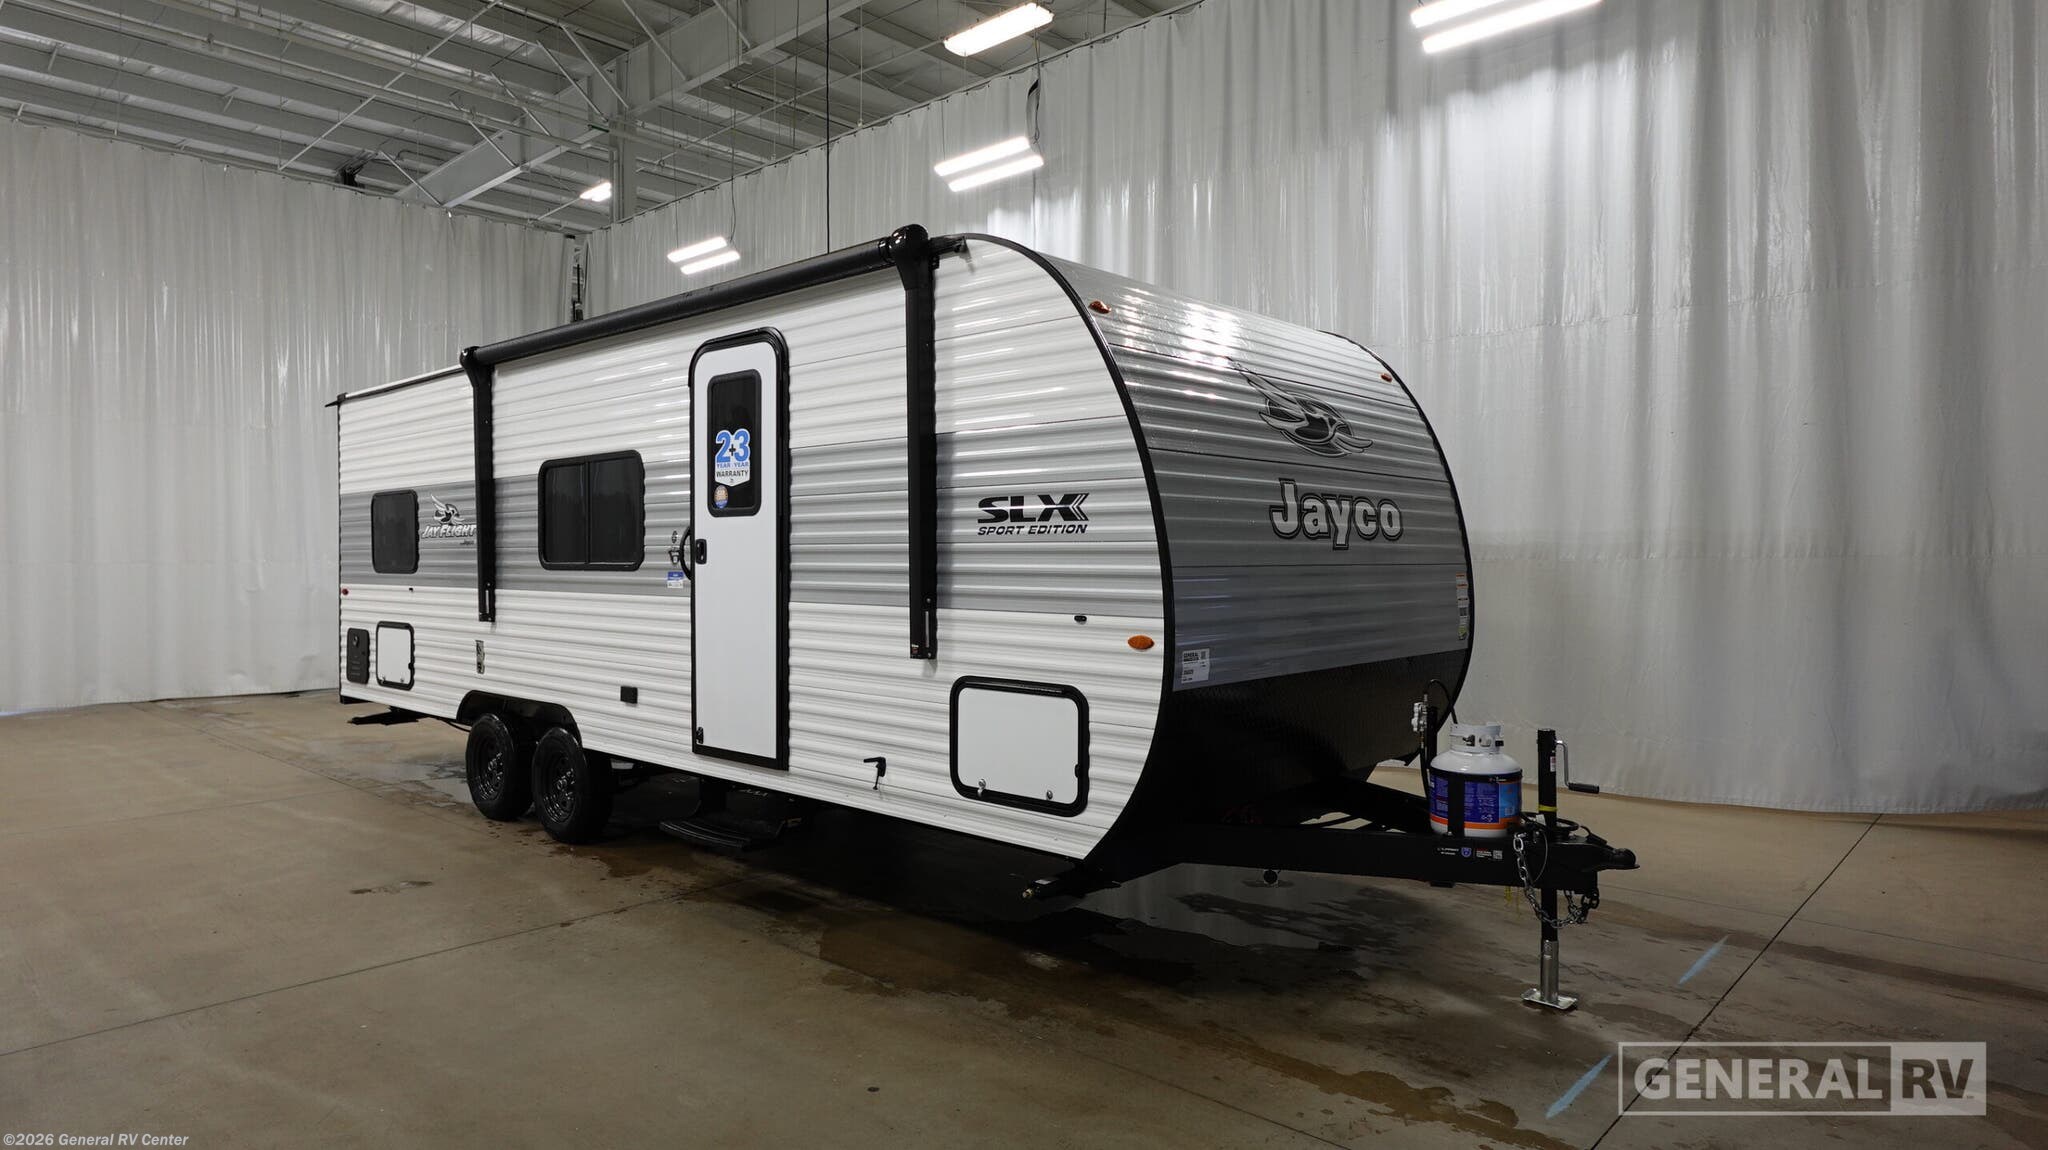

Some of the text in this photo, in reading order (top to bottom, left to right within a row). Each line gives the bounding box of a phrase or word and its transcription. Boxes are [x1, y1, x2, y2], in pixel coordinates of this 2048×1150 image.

[716, 470, 749, 479] WARRANTY
[978, 493, 1090, 523] SLX
[1269, 477, 1403, 550] Jayco
[421, 524, 477, 538] JAY FLIGHT
[978, 524, 1088, 535] SPORT EDITION
